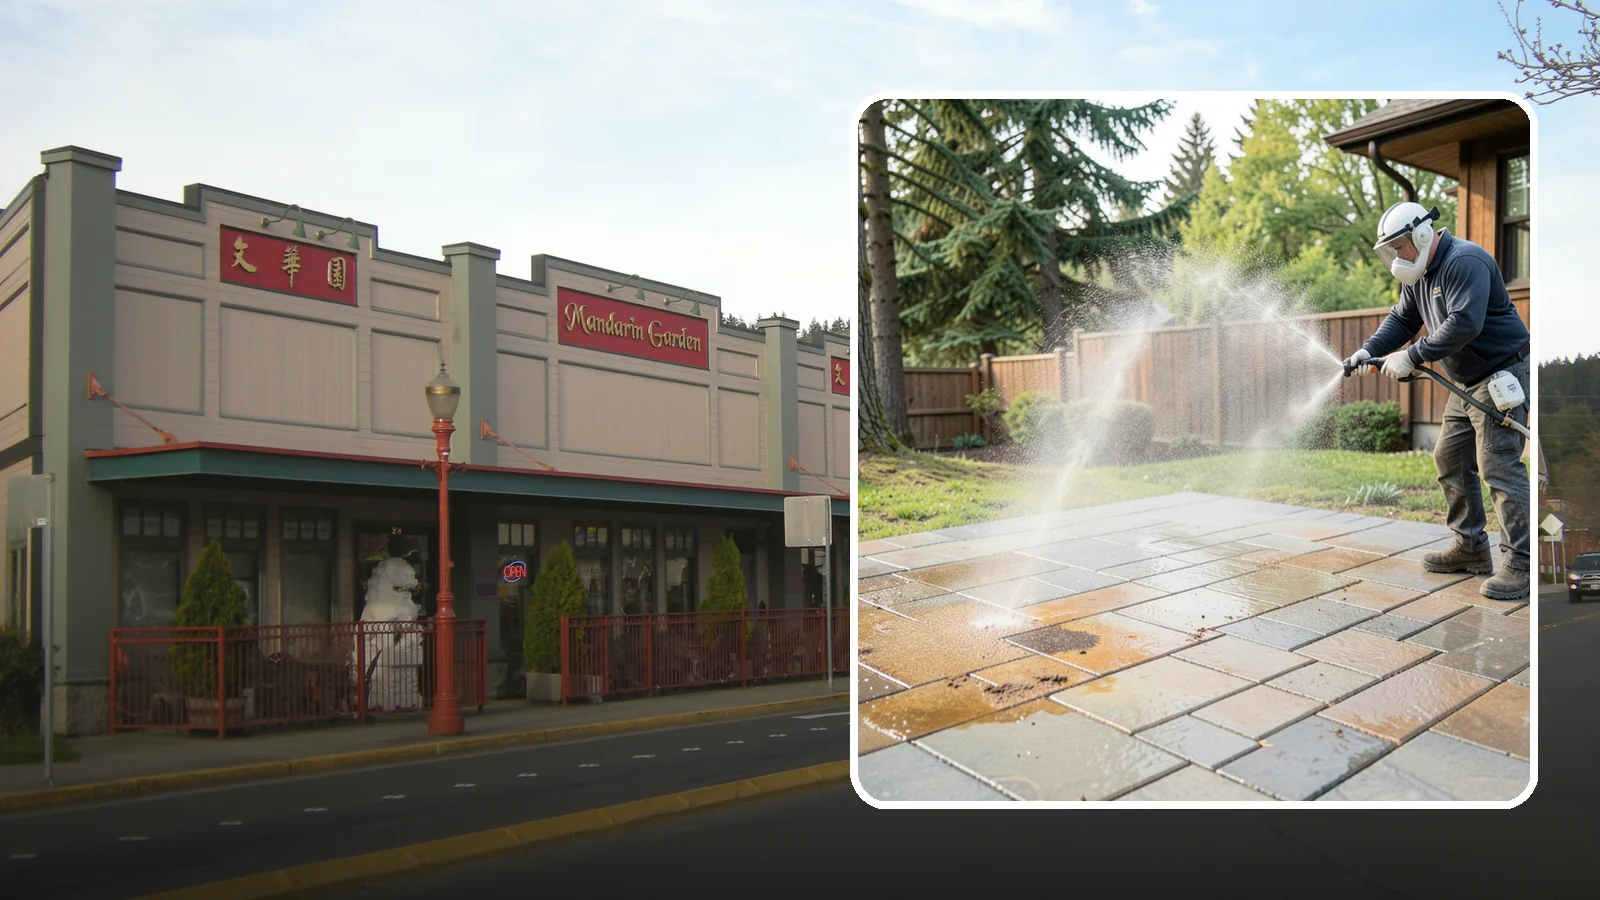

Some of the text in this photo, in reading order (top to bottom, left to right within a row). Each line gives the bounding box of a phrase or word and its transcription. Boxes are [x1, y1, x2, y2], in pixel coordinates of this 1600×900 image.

[231, 236, 346, 290] 文華園
[564, 302, 702, 352] Mandarin Garden
[503, 565, 527, 578] OPEN
